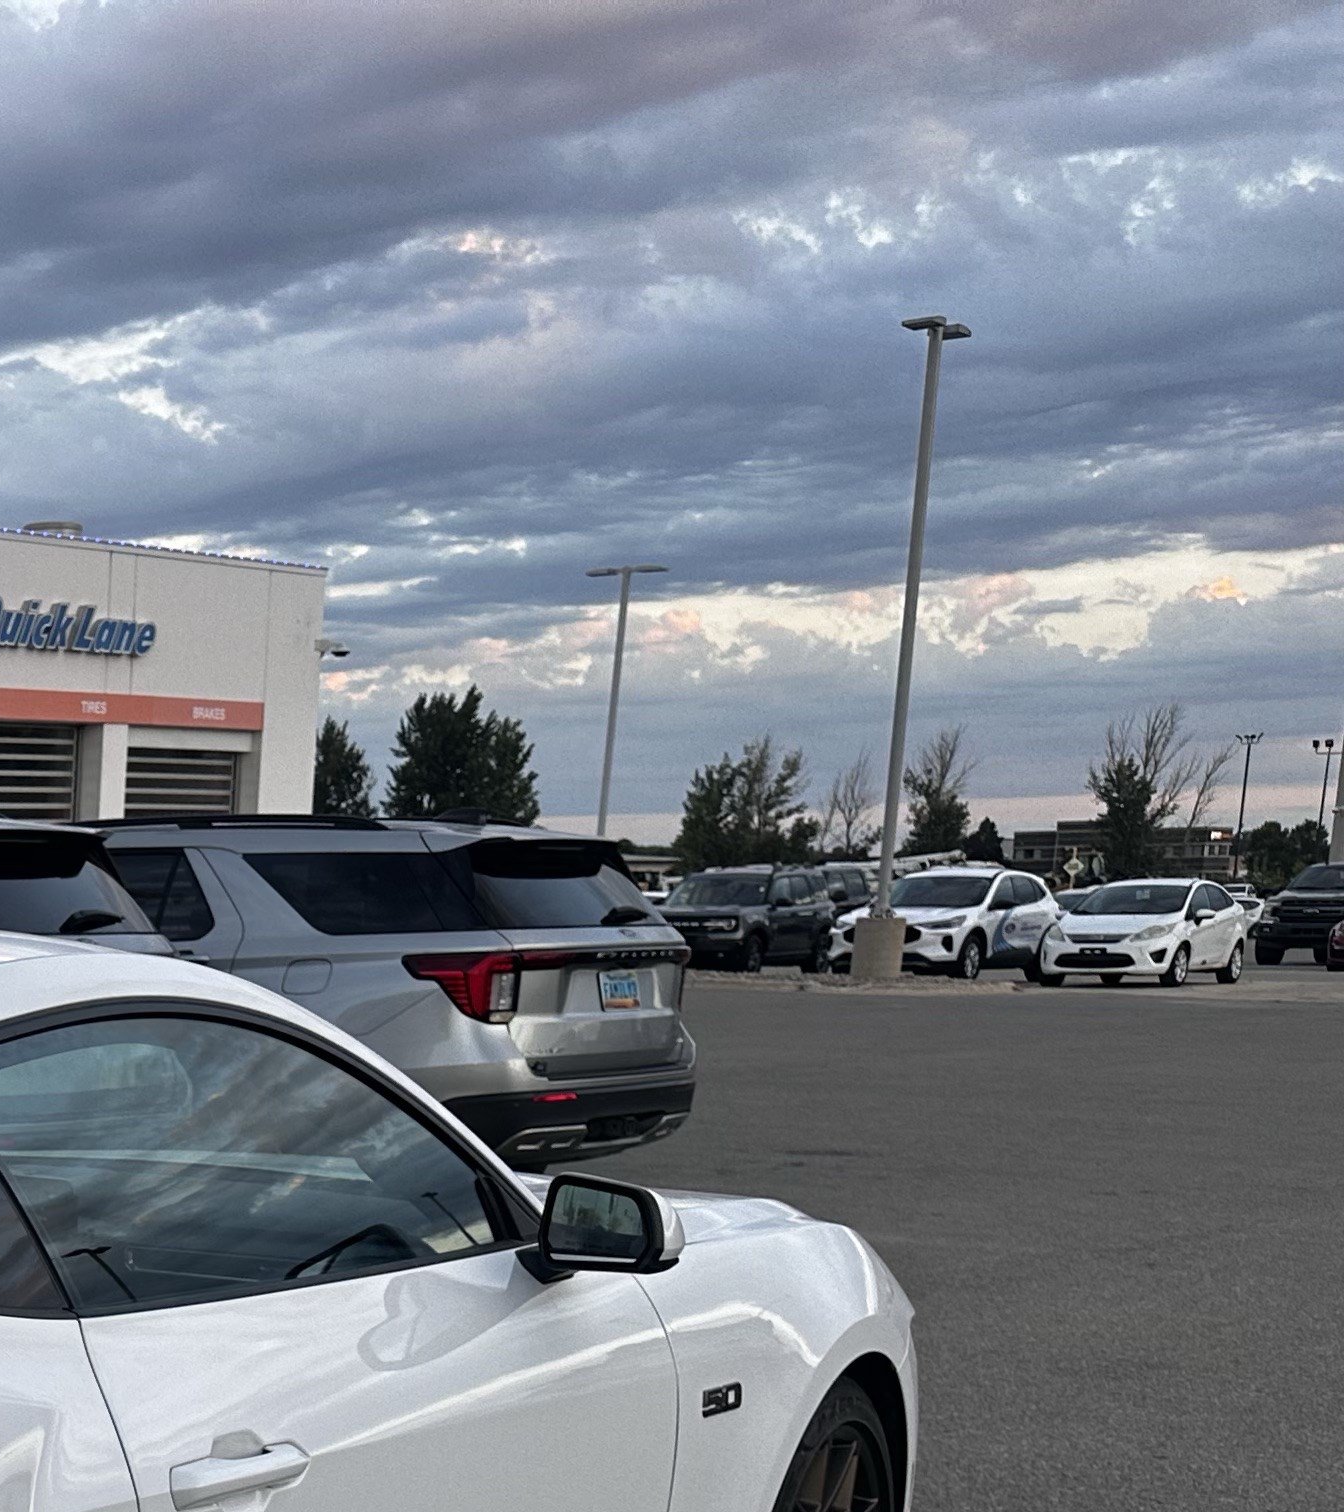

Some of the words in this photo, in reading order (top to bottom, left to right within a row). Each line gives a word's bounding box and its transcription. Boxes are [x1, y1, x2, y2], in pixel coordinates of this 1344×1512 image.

[75, 604, 156, 656] Lane
[81, 700, 107, 715] TIRES
[192, 706, 226, 720] BRAKES
